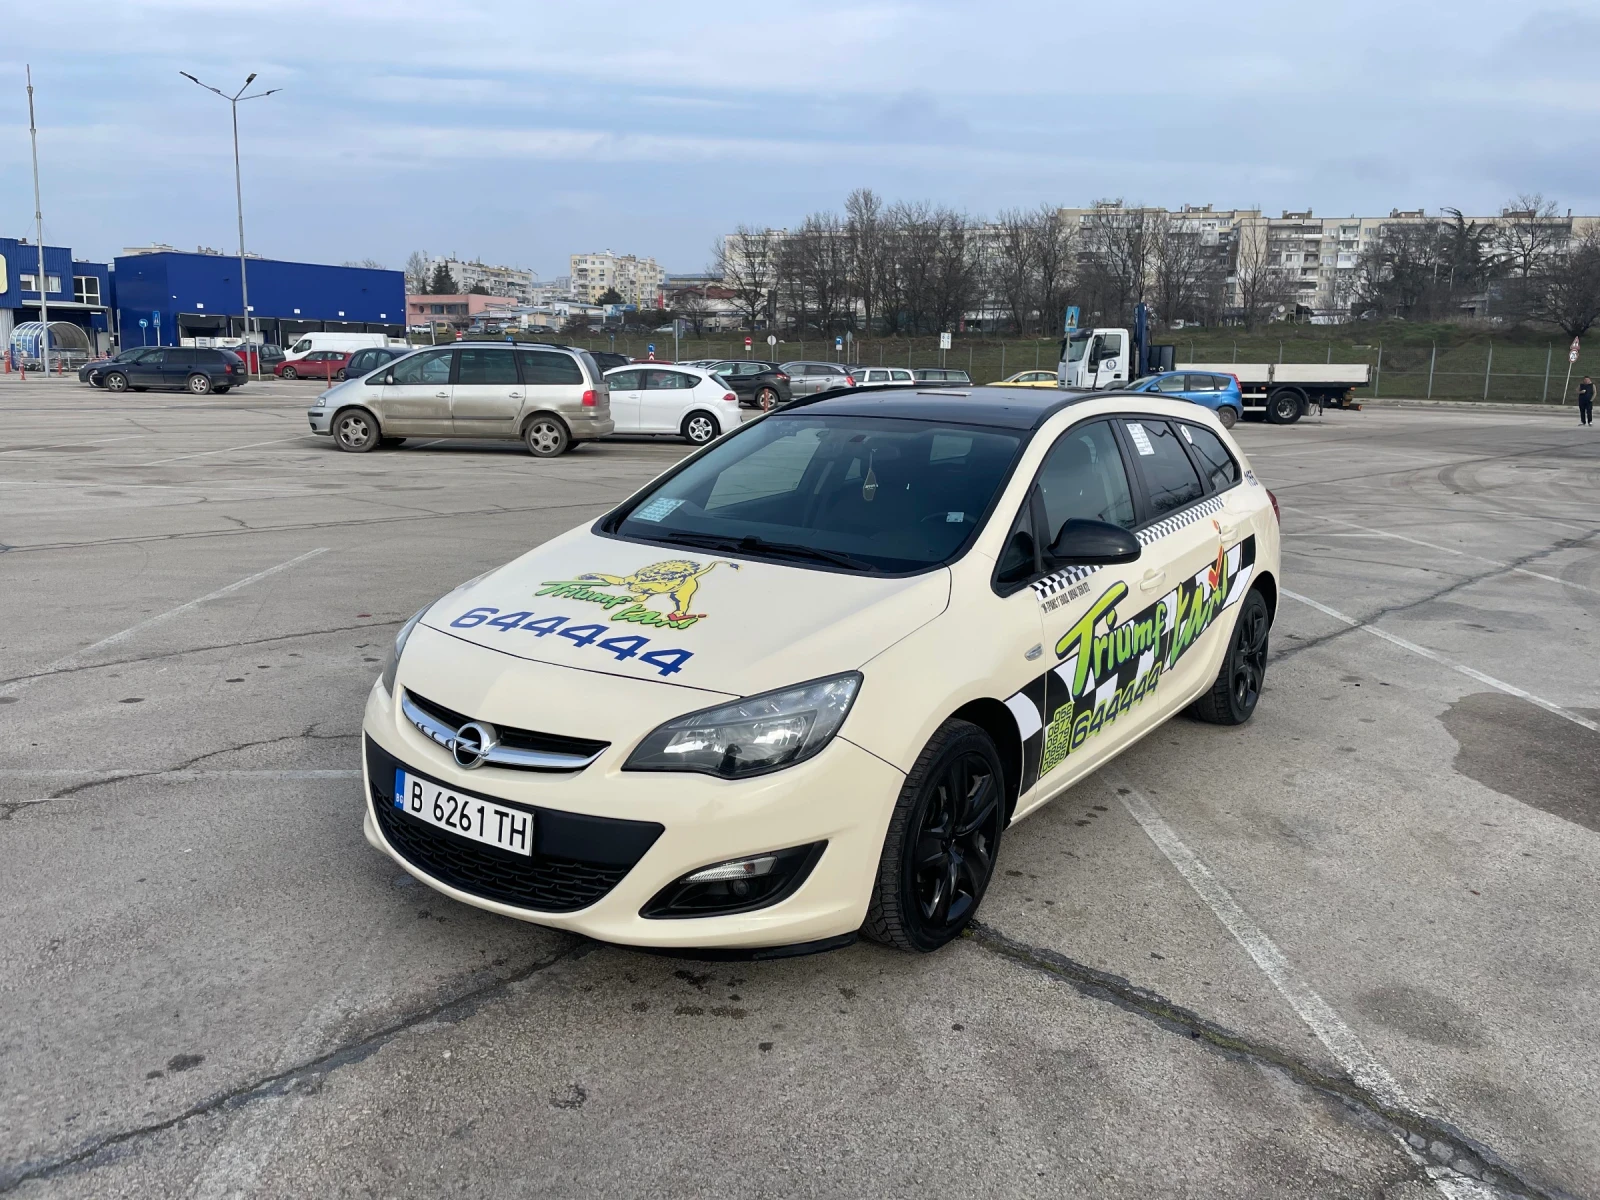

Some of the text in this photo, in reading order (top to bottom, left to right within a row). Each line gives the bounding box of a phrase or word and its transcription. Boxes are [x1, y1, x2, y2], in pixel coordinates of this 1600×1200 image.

[535, 580, 637, 610] Triumf
[449, 607, 695, 677] 644444
[1055, 580, 1168, 698] Triumf
[1048, 715, 1071, 739] 0877
[1070, 661, 1163, 753] 644444
[395, 792, 404, 804] BG
[411, 780, 527, 850] B 6261 TH
